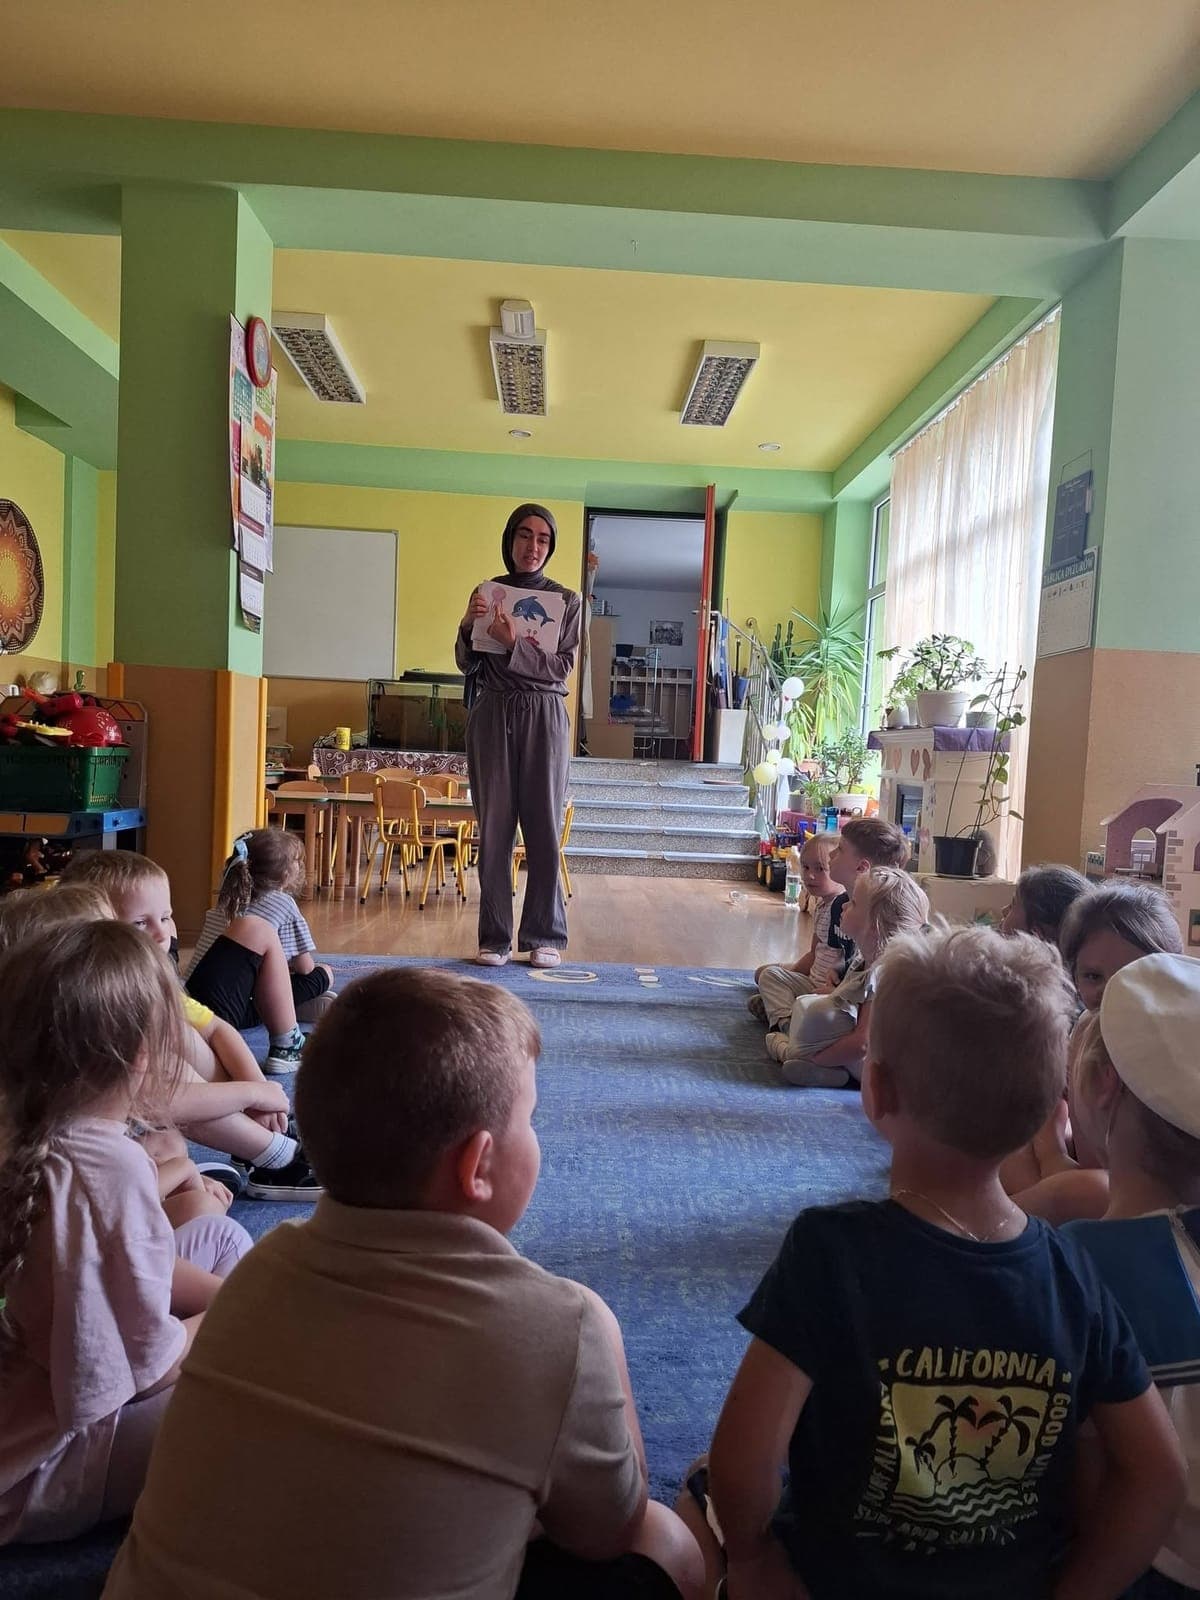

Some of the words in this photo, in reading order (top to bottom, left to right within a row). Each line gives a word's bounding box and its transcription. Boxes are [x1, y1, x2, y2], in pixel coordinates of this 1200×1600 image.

[879, 1381, 896, 1426] DAY
[1040, 1392, 1072, 1447] GOOD
[874, 1432, 897, 1471] ALL
